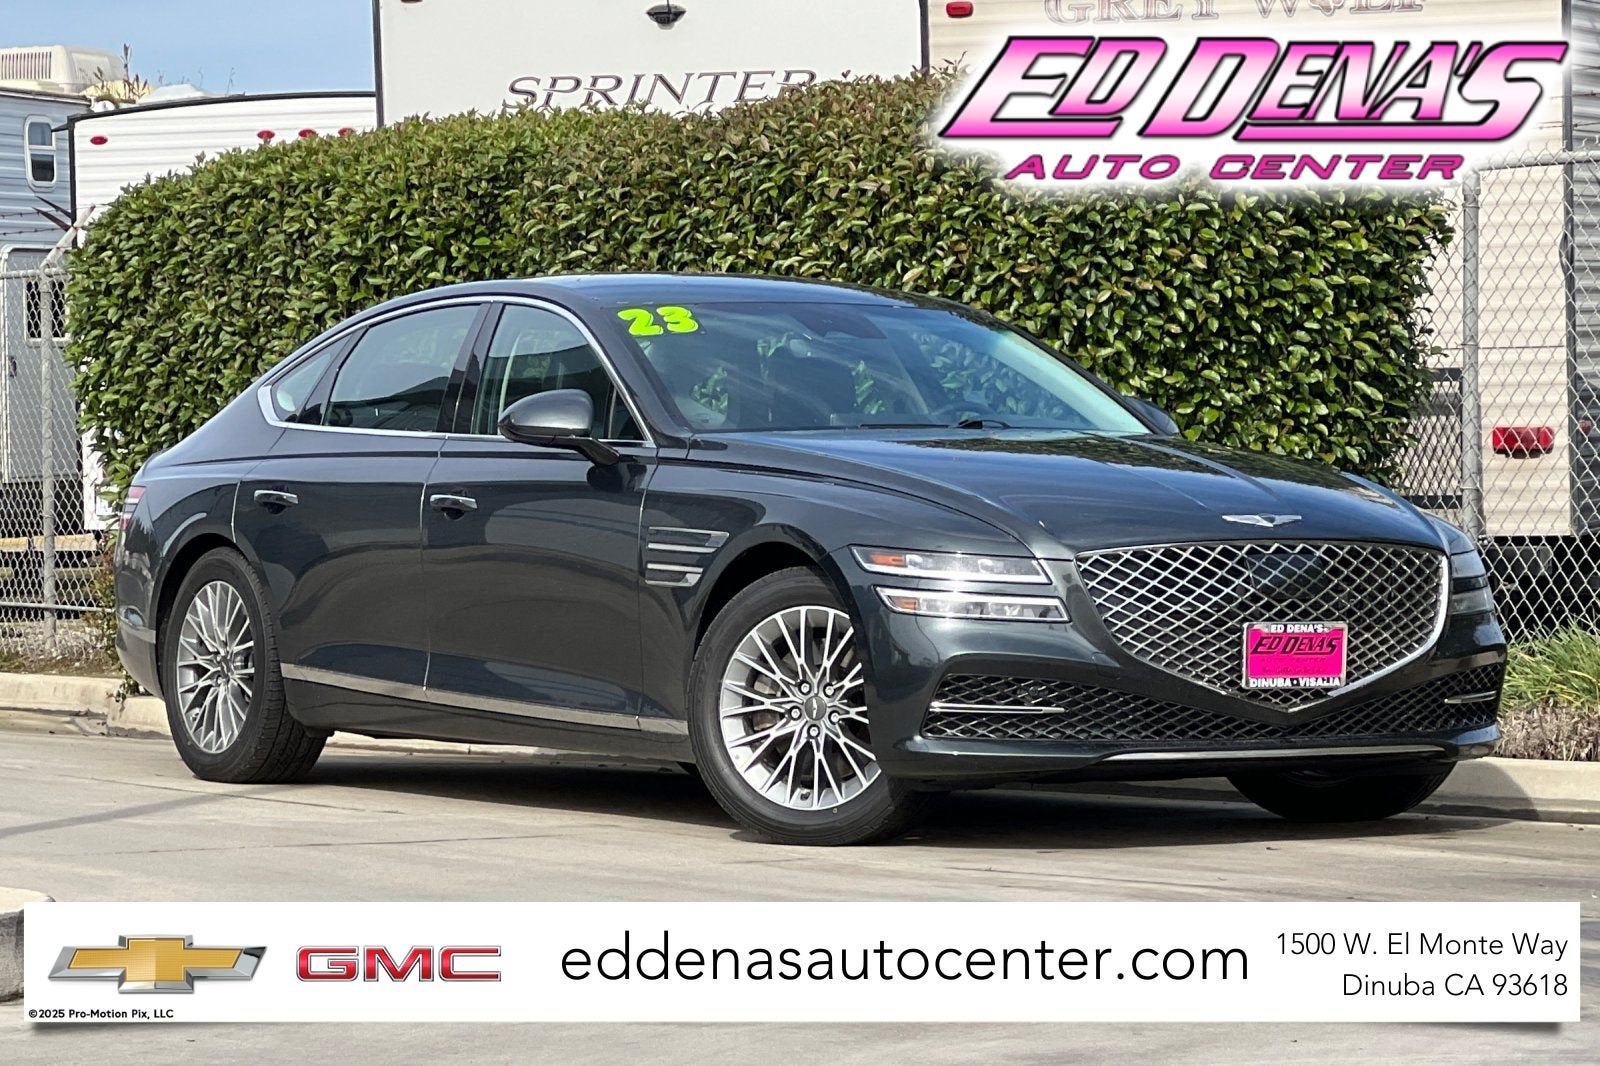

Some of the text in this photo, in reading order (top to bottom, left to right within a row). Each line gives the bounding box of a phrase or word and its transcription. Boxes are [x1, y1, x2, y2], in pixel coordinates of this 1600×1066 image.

[617, 306, 699, 336] 23
[1270, 624, 1325, 633] ED DENA'S
[1250, 636, 1283, 655] ED
[1249, 677, 1340, 688] DINUBA VISALIA
